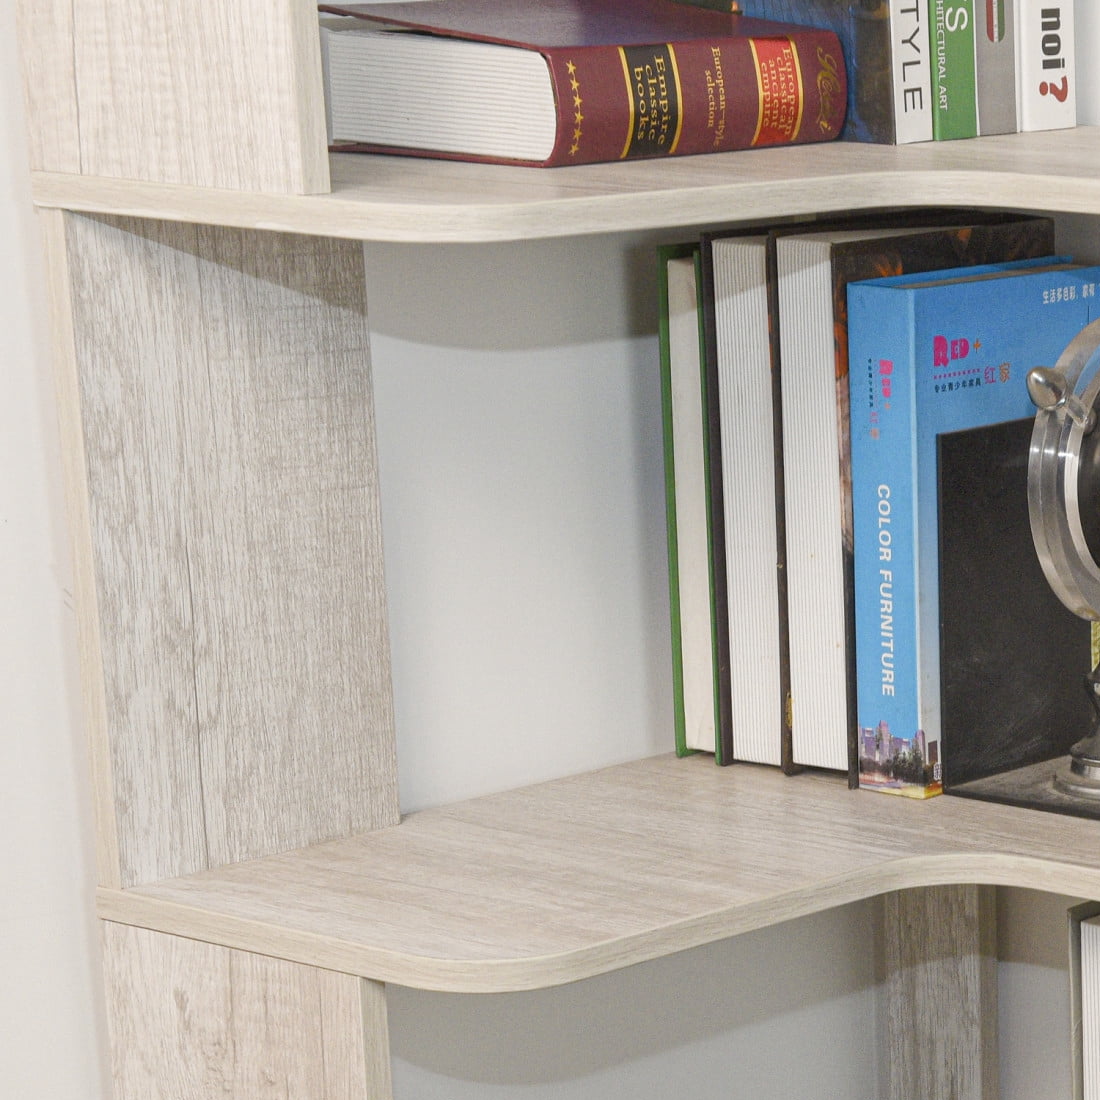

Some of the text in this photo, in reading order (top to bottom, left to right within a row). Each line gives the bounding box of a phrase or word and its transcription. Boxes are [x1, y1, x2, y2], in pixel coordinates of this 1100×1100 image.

[761, 62, 770, 127] empire
[768, 60, 778, 128] ancient
[783, 48, 796, 136] European
[900, 0, 923, 113] TYLE
[936, 0, 948, 111] HITECTURAL ART
[634, 67, 647, 141] books
[645, 65, 656, 140] classic
[653, 55, 671, 145] Empire
[705, 70, 714, 128] selection
[877, 484, 895, 698] COLOR FURNITURE
